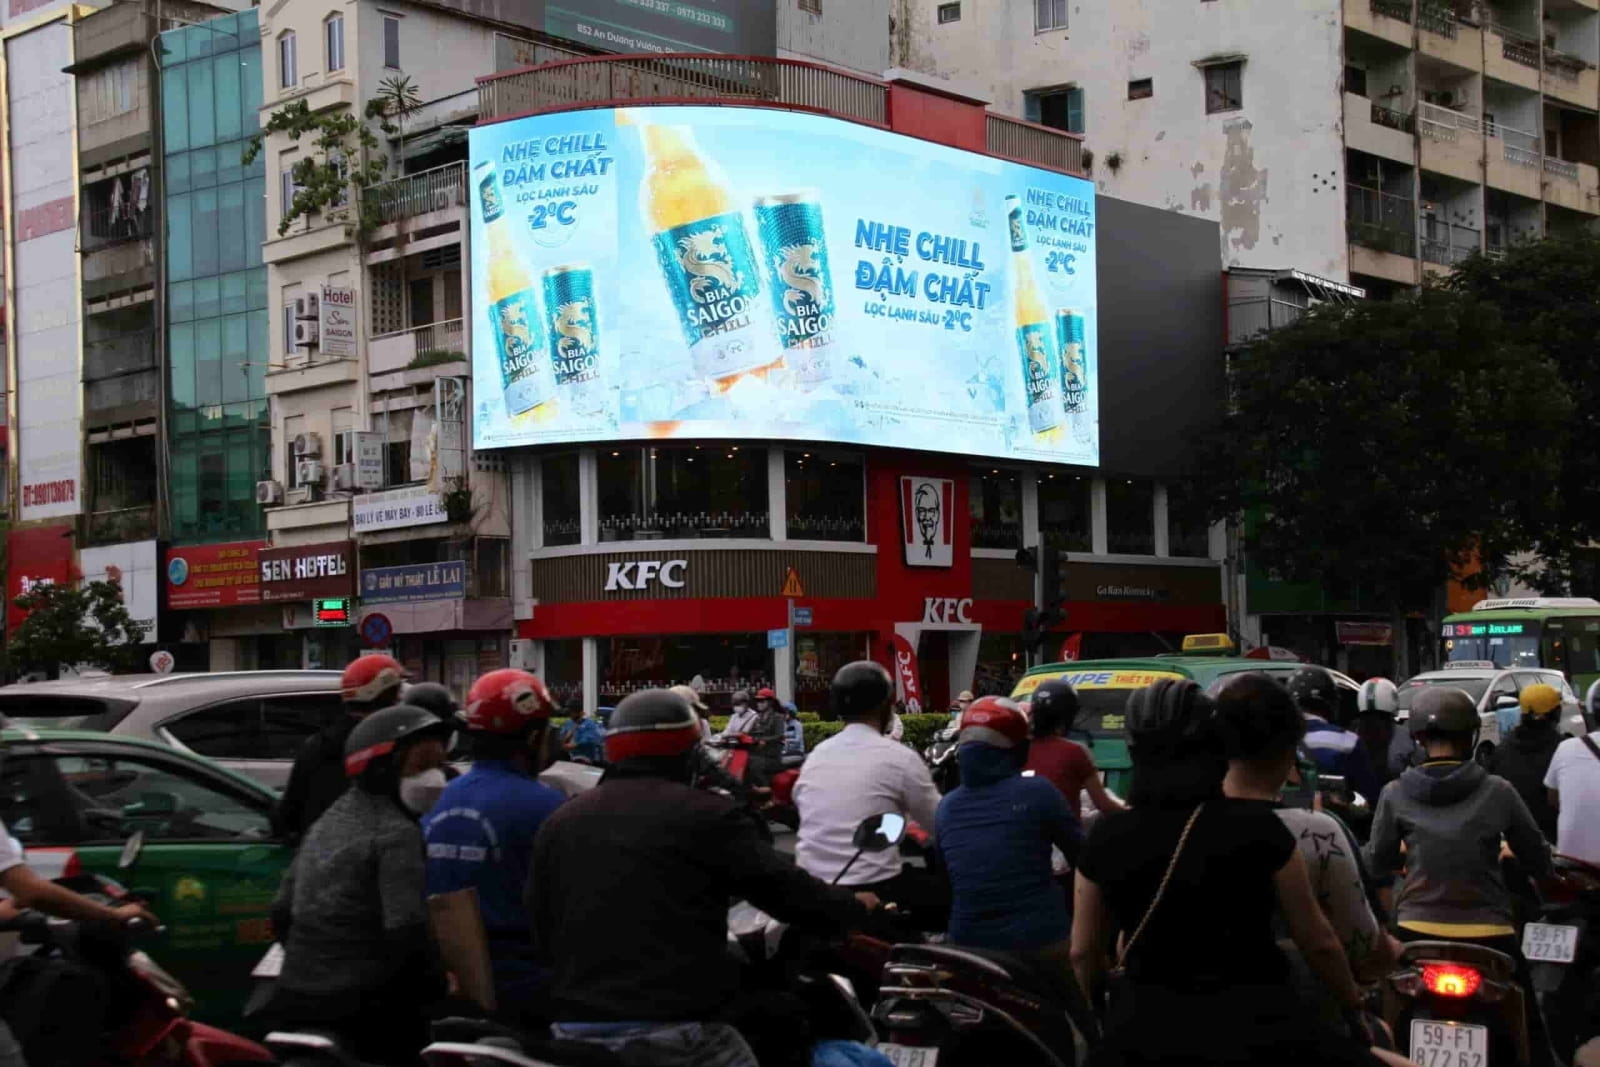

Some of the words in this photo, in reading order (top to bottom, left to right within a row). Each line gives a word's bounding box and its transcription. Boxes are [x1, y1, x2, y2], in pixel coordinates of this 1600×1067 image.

[594, 28, 606, 39] An
[502, 139, 541, 163] NHẸ
[545, 133, 607, 156] CHILL
[503, 161, 547, 189] ĐẬM
[550, 151, 614, 180] CHẤT
[516, 191, 536, 205] LỌC
[538, 186, 570, 202] LẠNH
[572, 184, 599, 196] SÂU
[1026, 188, 1055, 212] NHẸ
[1056, 195, 1091, 216] CHILL
[1060, 217, 1095, 238] CHẤT
[855, 218, 911, 263] NHẸ
[916, 231, 985, 271] CHILL
[855, 257, 919, 301] ĐẬM
[923, 270, 991, 310] CHẤT
[323, 288, 353, 304] Hotel
[705, 287, 730, 304] BIA
[796, 304, 819, 318] BIA
[864, 302, 887, 318] LỌC
[888, 305, 918, 323] LẠNH
[919, 308, 940, 325] SÂU
[777, 313, 834, 337] SAIGO
[513, 344, 528, 357] BIA
[567, 347, 587, 359] BIA
[262, 559, 291, 582] SEN
[294, 554, 347, 580] HOTEL
[427, 565, 440, 585] LÊ
[443, 567, 460, 584] LAI
[604, 559, 688, 591] KFC
[922, 597, 974, 624] KFC
[897, 650, 916, 693] KFC
[1532, 926, 1568, 944] 59-F1
[1423, 1026, 1474, 1050] 59-F1
